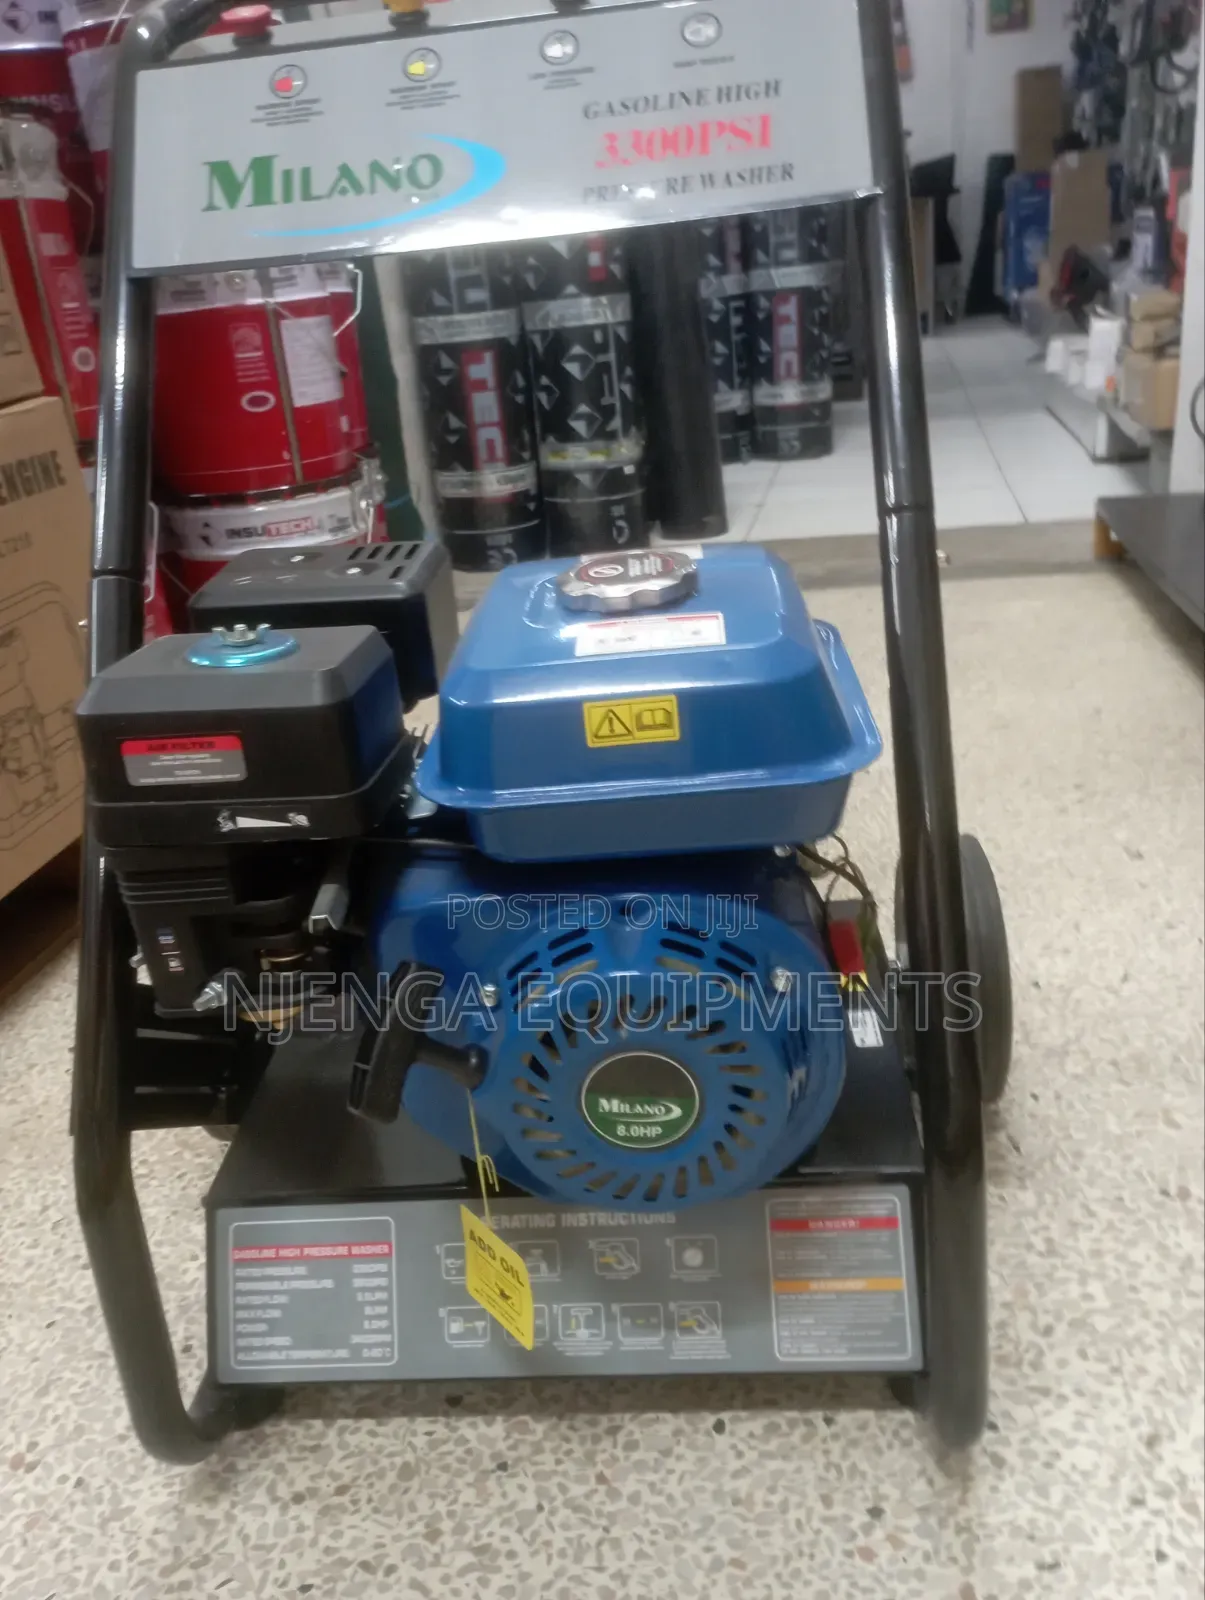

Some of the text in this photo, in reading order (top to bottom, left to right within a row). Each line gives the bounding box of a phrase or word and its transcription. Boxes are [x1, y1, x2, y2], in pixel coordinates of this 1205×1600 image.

[582, 79, 783, 121] GASOLINE HIGH
[594, 113, 774, 169] 3300PSI
[201, 153, 444, 213] MILANO
[700, 162, 795, 191] WASHER
[599, 1098, 665, 1115] MILANO
[469, 1229, 525, 1288] ADD OIL
